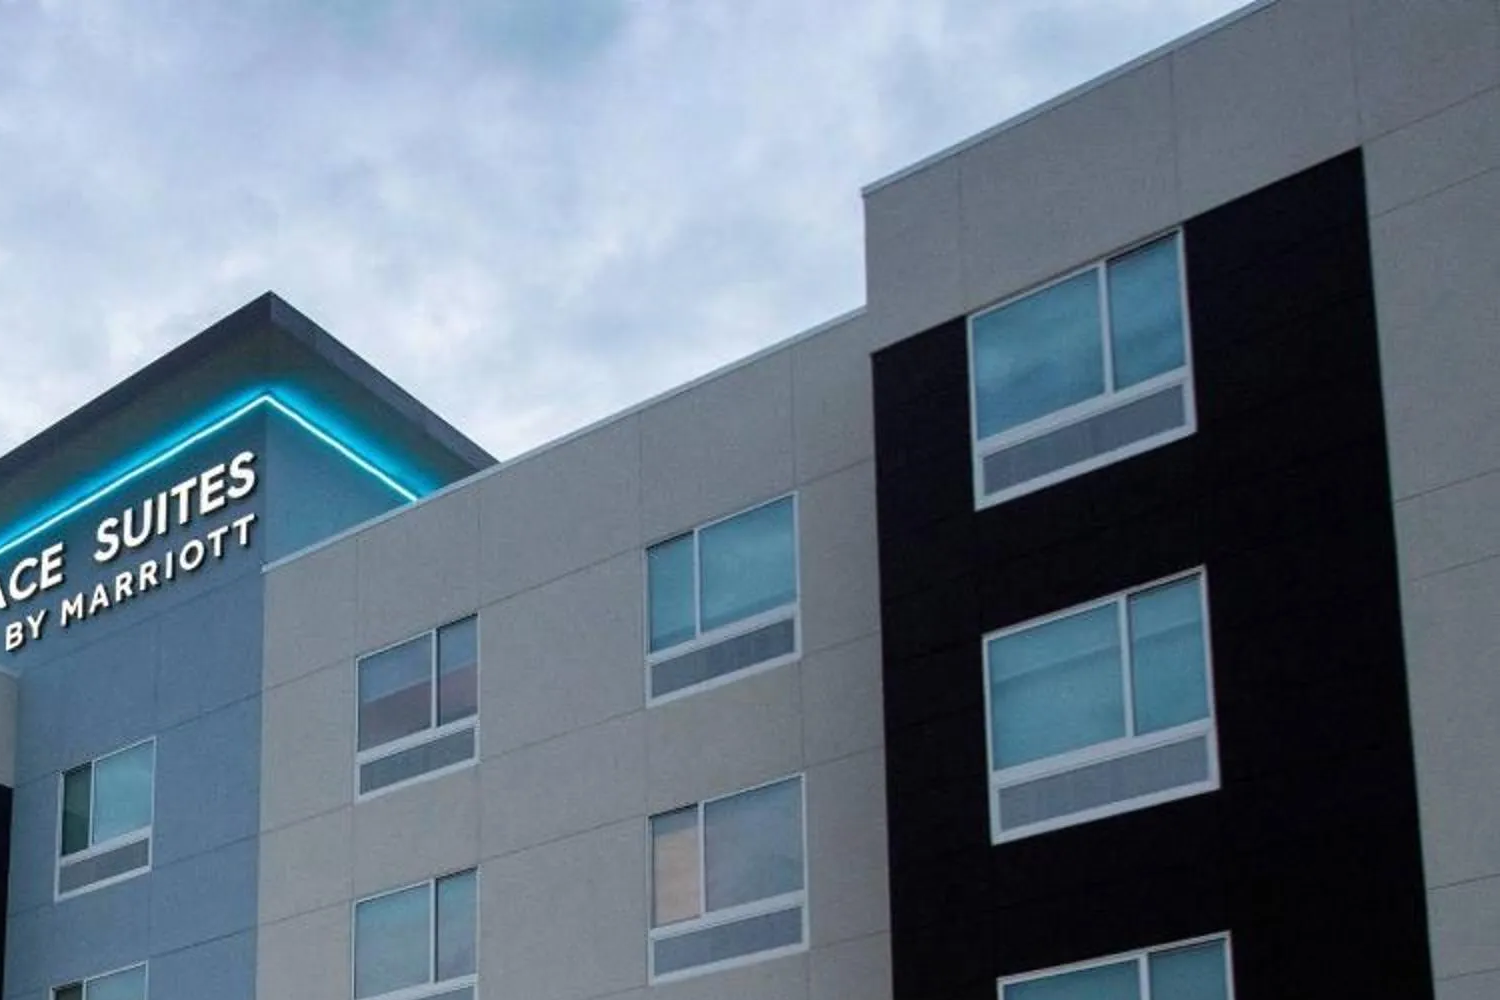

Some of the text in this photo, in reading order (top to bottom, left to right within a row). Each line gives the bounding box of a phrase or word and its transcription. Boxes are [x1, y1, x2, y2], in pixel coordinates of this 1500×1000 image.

[94, 450, 256, 562] SUITES
[5, 513, 256, 651] BY MARRIOTT
